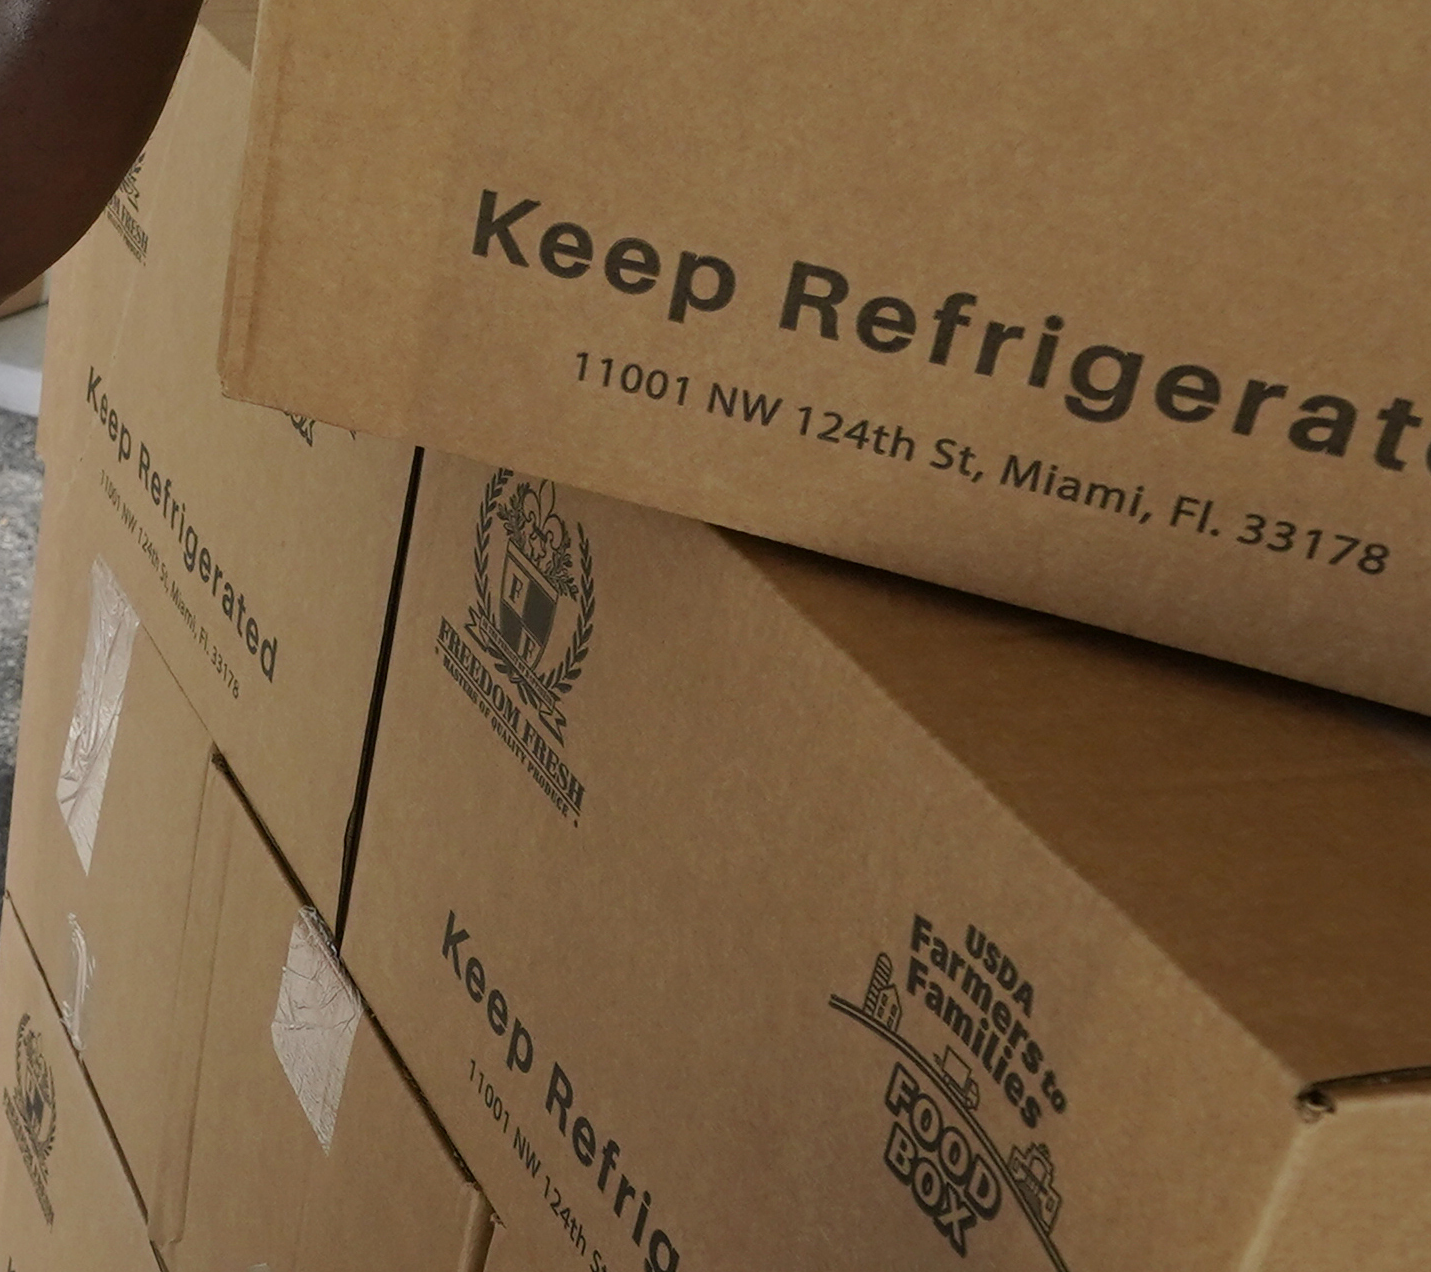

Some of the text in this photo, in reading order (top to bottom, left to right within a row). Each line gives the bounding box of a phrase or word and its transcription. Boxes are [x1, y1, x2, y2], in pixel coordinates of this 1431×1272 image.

[471, 188, 738, 325] Keep
[87, 366, 131, 463] Keep
[138, 441, 278, 683] Refrigerated
[574, 350, 1390, 577] 11001 NW 124th St, Miami, Fl. 33178
[100, 469, 239, 699] 11001 NW 124th St, Miami, Fl. 33178
[509, 572, 524, 604] F
[521, 633, 537, 662] F
[438, 615, 521, 734] FREEDOM
[522, 718, 586, 811] FRESH
[443, 654, 477, 705] MASTERS
[479, 701, 490, 718] OF
[491, 715, 527, 764] QUALITY
[527, 762, 570, 818] PRODUCE
[442, 910, 534, 1074] Keep
[907, 957, 1042, 1129] Families
[911, 913, 1068, 1114] Farmers to
[966, 924, 1034, 1018] USDA
[468, 1058, 510, 1134] 11001
[513, 1127, 540, 1179] NW
[543, 1174, 588, 1258] 124th
[884, 1122, 977, 1258] BOX
[885, 1061, 1002, 1221] FOOD
